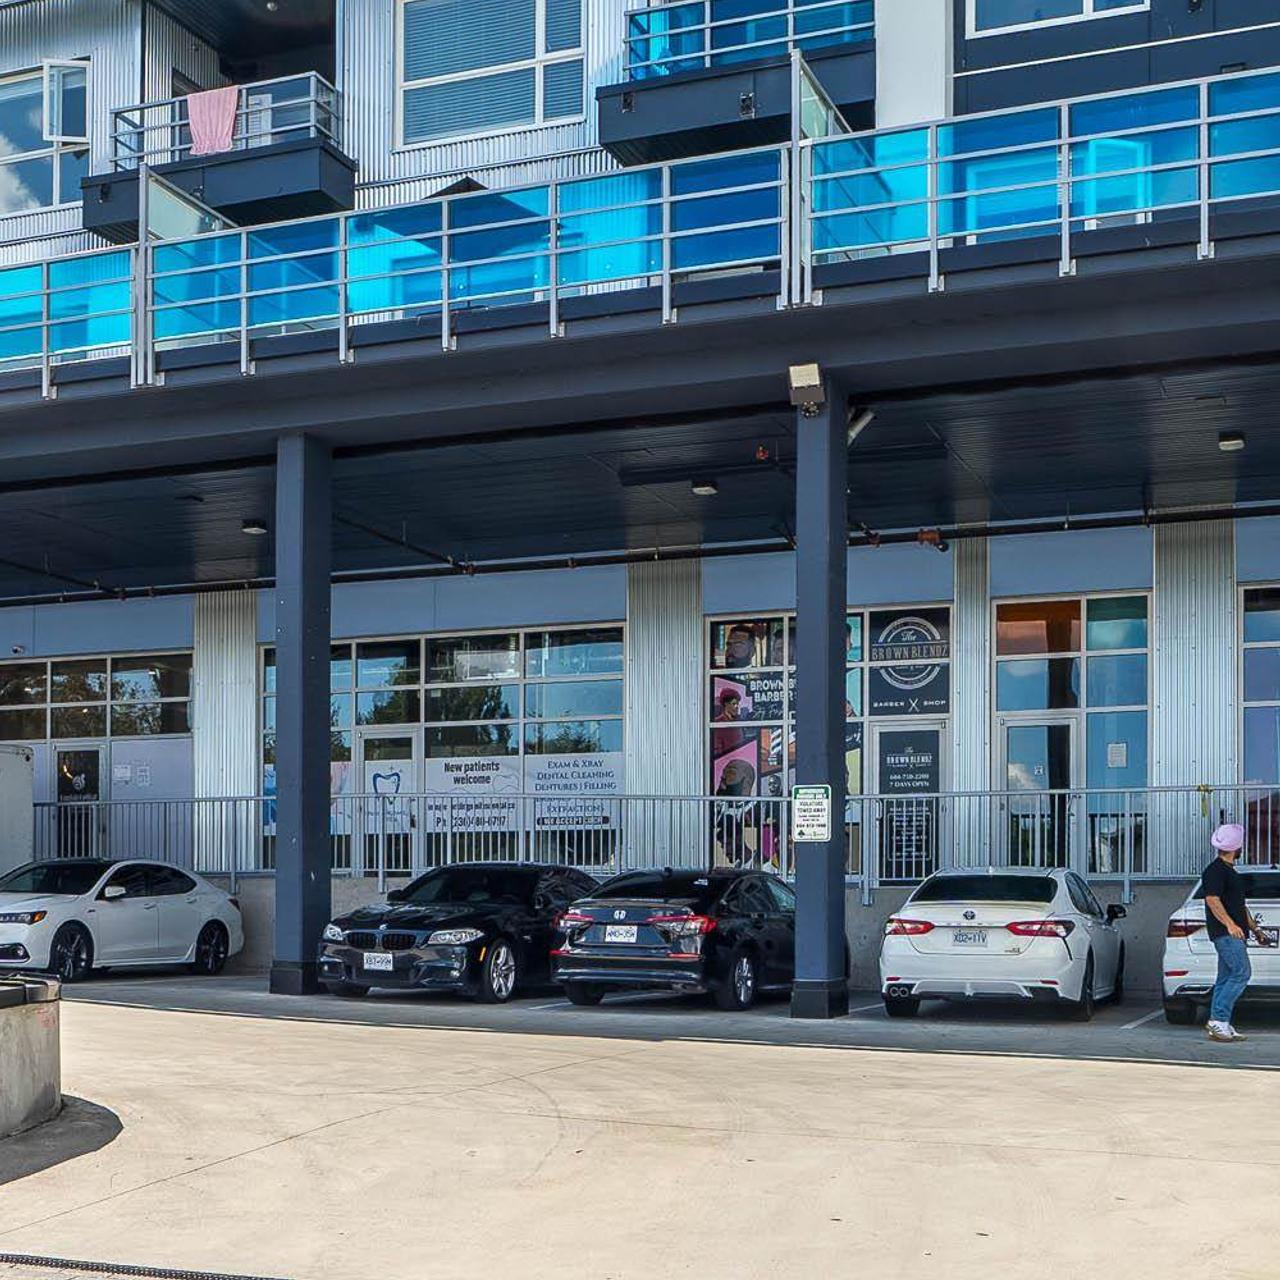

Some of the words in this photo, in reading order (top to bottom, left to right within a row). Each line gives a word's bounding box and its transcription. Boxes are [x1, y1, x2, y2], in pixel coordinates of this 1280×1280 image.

[871, 646, 909, 660] BROWN
[911, 644, 949, 658] BLENDZ
[444, 763, 462, 772] New
[464, 761, 500, 773] patients
[547, 761, 570, 769] EXAM
[572, 760, 580, 768] &
[581, 759, 604, 768] XRAY
[453, 774, 491, 784] welcome
[537, 772, 569, 780] DENTAL
[570, 771, 615, 779] CLEANING
[535, 783, 578, 791] DENTURES
[584, 782, 617, 790] FILLING
